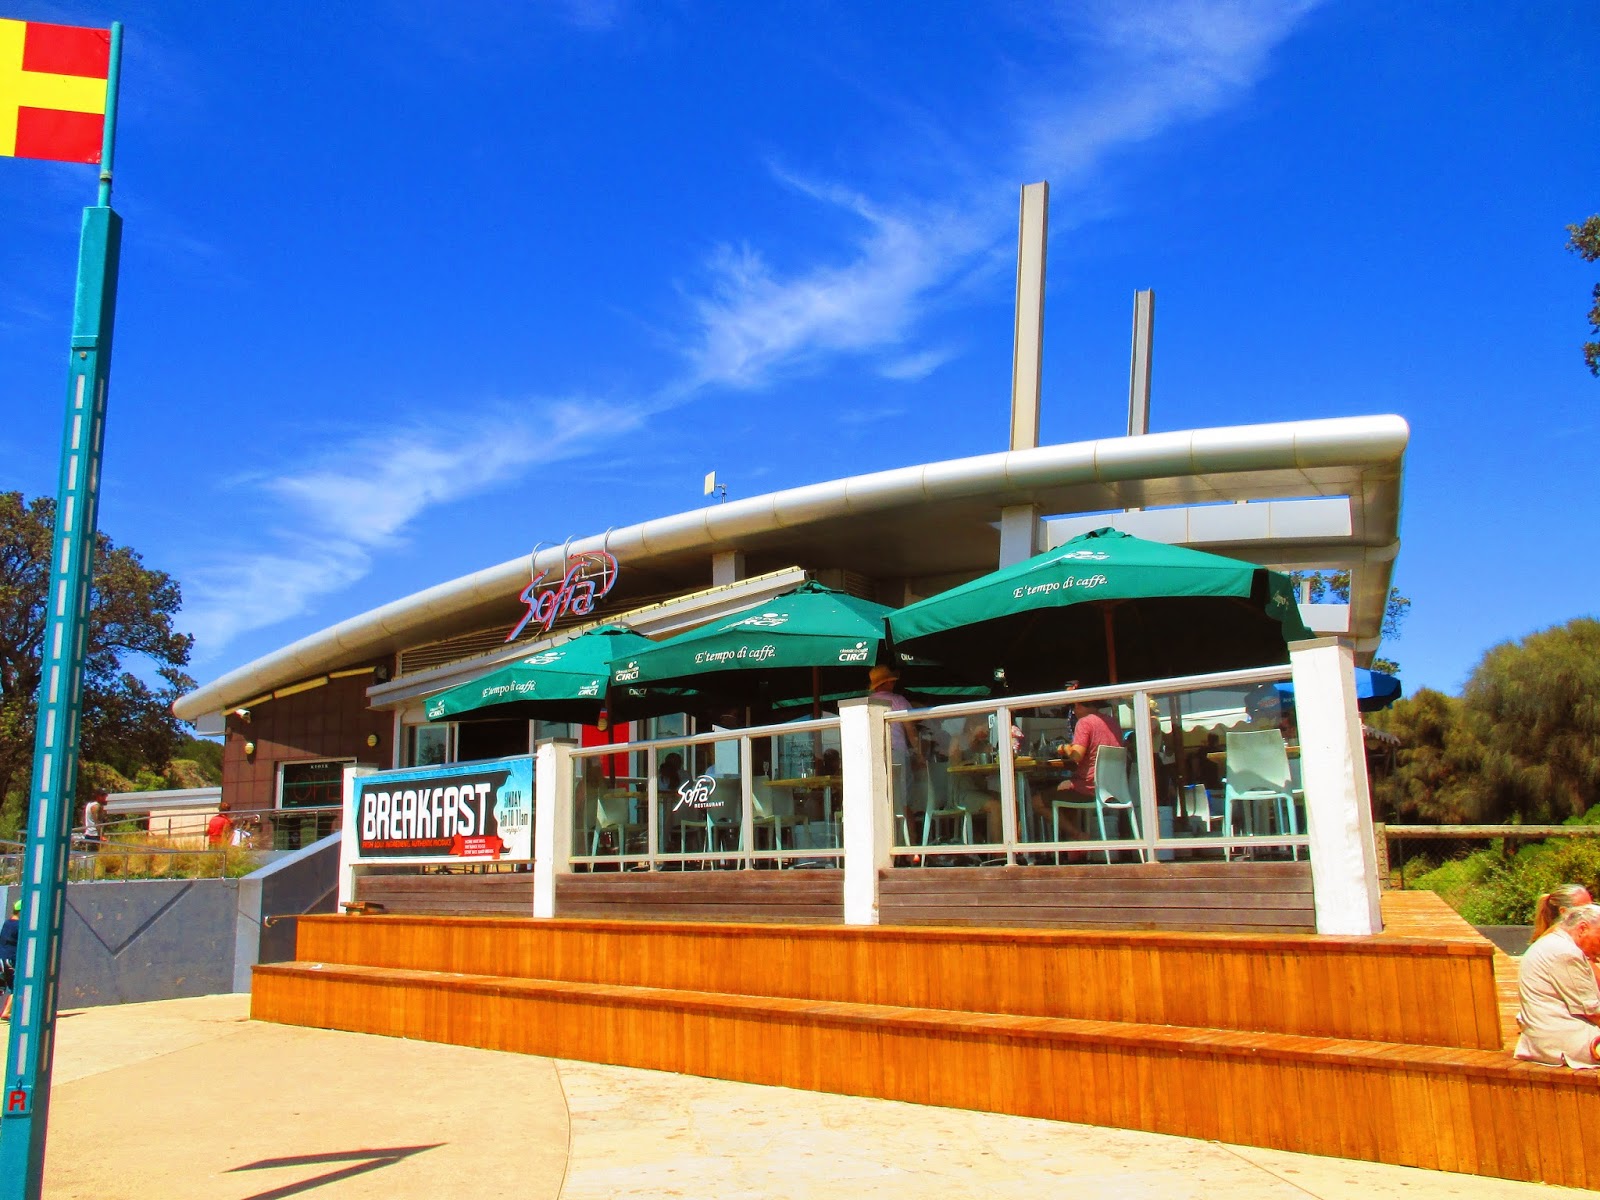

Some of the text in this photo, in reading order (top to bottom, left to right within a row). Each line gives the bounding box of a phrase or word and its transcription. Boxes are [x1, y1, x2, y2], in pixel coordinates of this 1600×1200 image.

[1063, 576, 1074, 589] di
[504, 550, 619, 643] Sofia
[736, 645, 747, 659] di
[838, 652, 868, 662] CIRCI
[615, 670, 639, 682] CIRCI
[672, 774, 716, 812] Sofia
[363, 783, 491, 841] BREAKFAST
[694, 801, 725, 809] RESTAURANT
[8, 1090, 27, 1111] R
